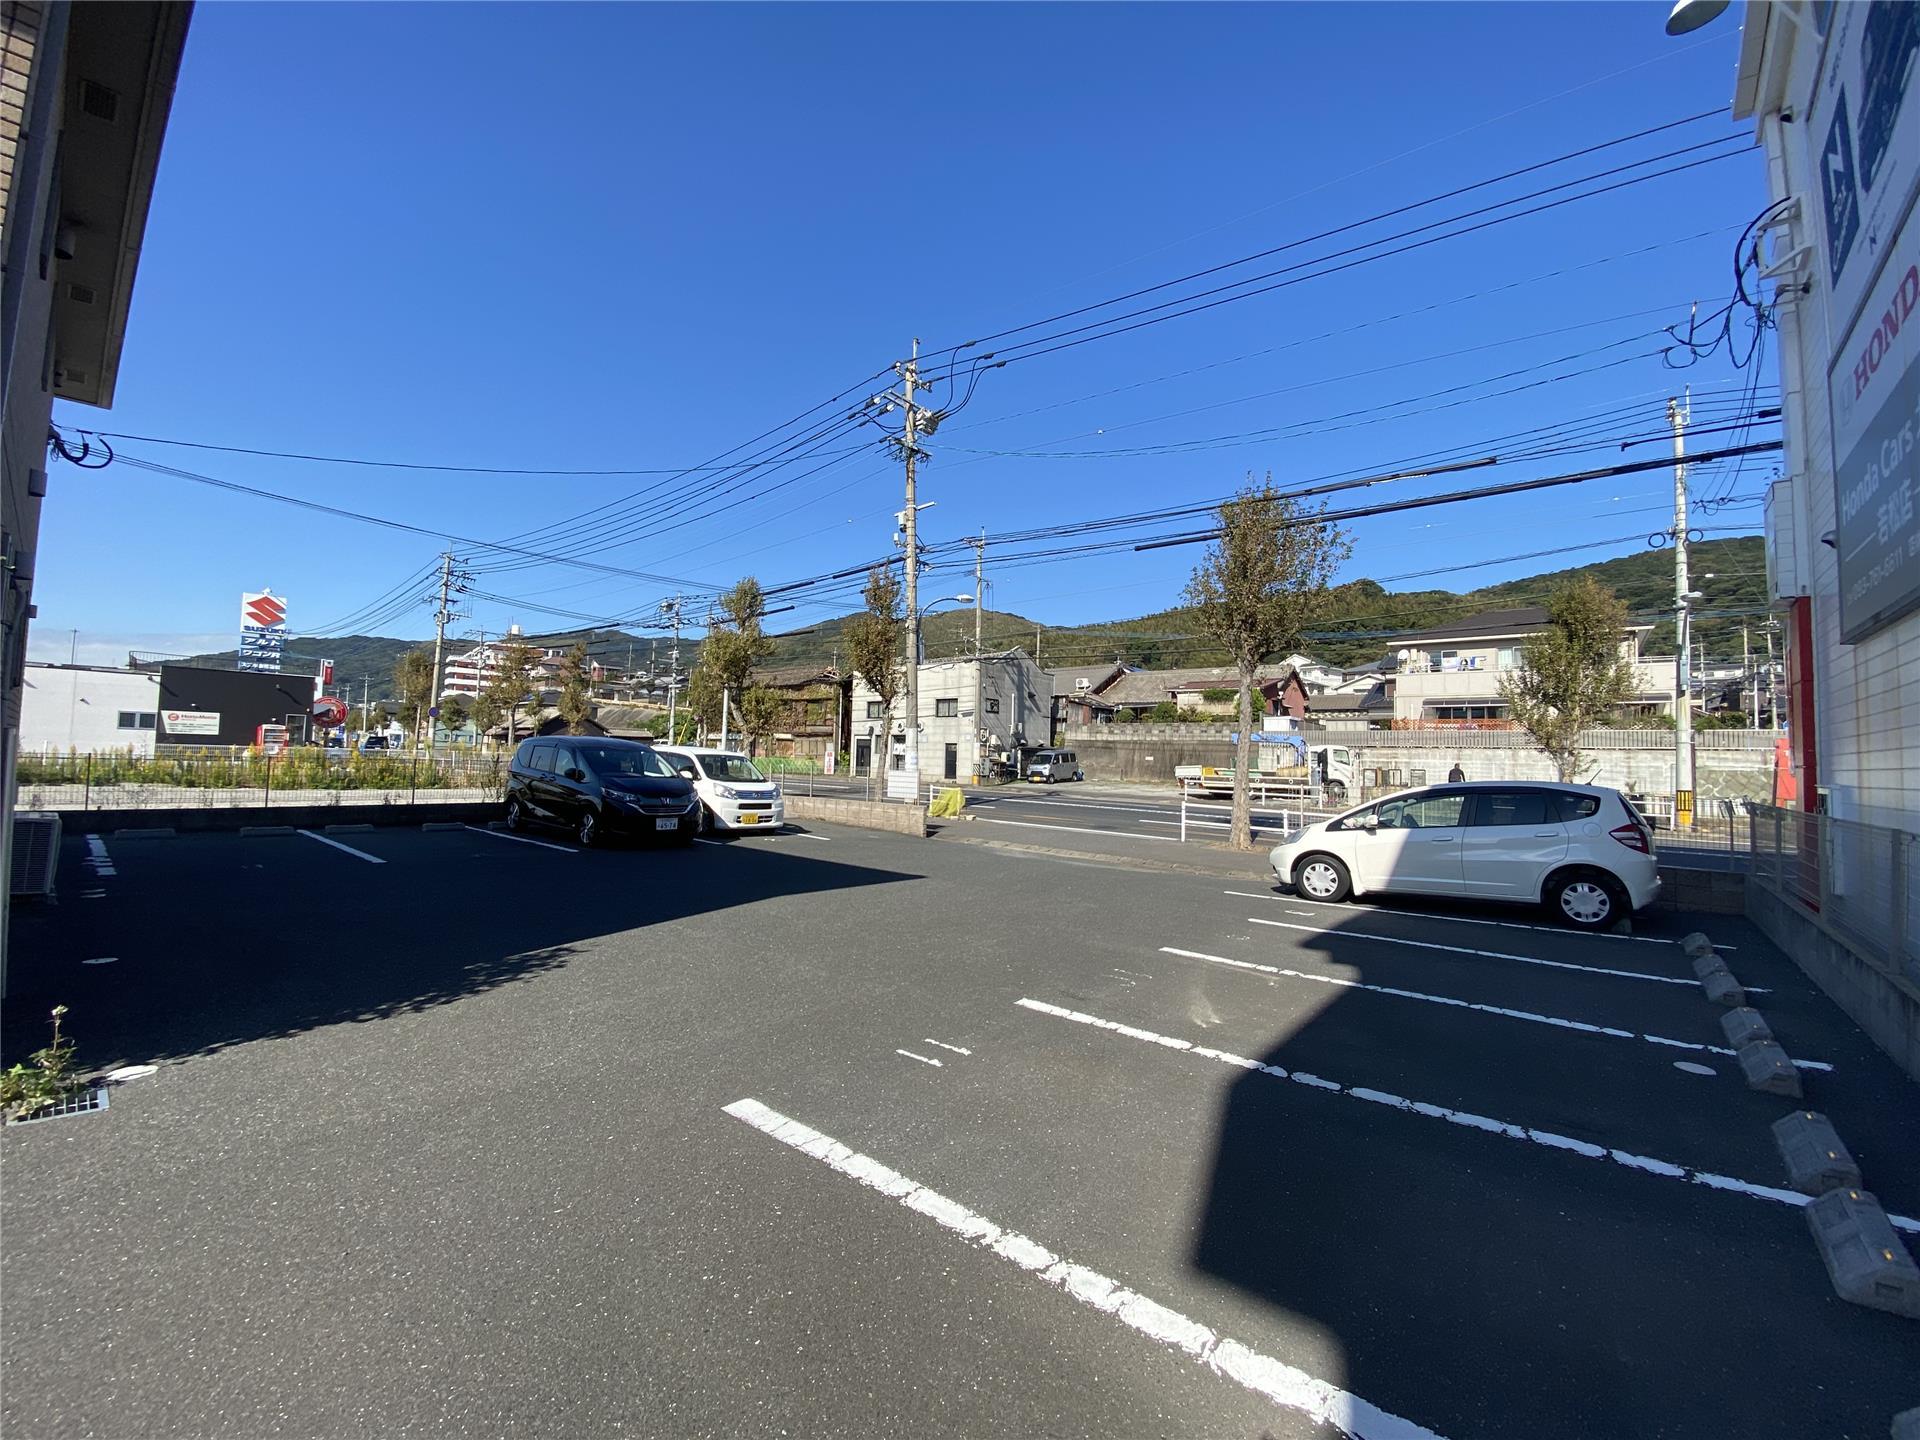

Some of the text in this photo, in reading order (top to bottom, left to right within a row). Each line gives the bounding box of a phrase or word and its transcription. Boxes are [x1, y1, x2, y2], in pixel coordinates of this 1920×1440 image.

[1853, 264, 1920, 401] HOND
[1842, 419, 1913, 527] Honda Cars
[243, 625, 292, 636] SUZUKI
[244, 637, 280, 647] アルト
[242, 649, 280, 659] ワゴンR
